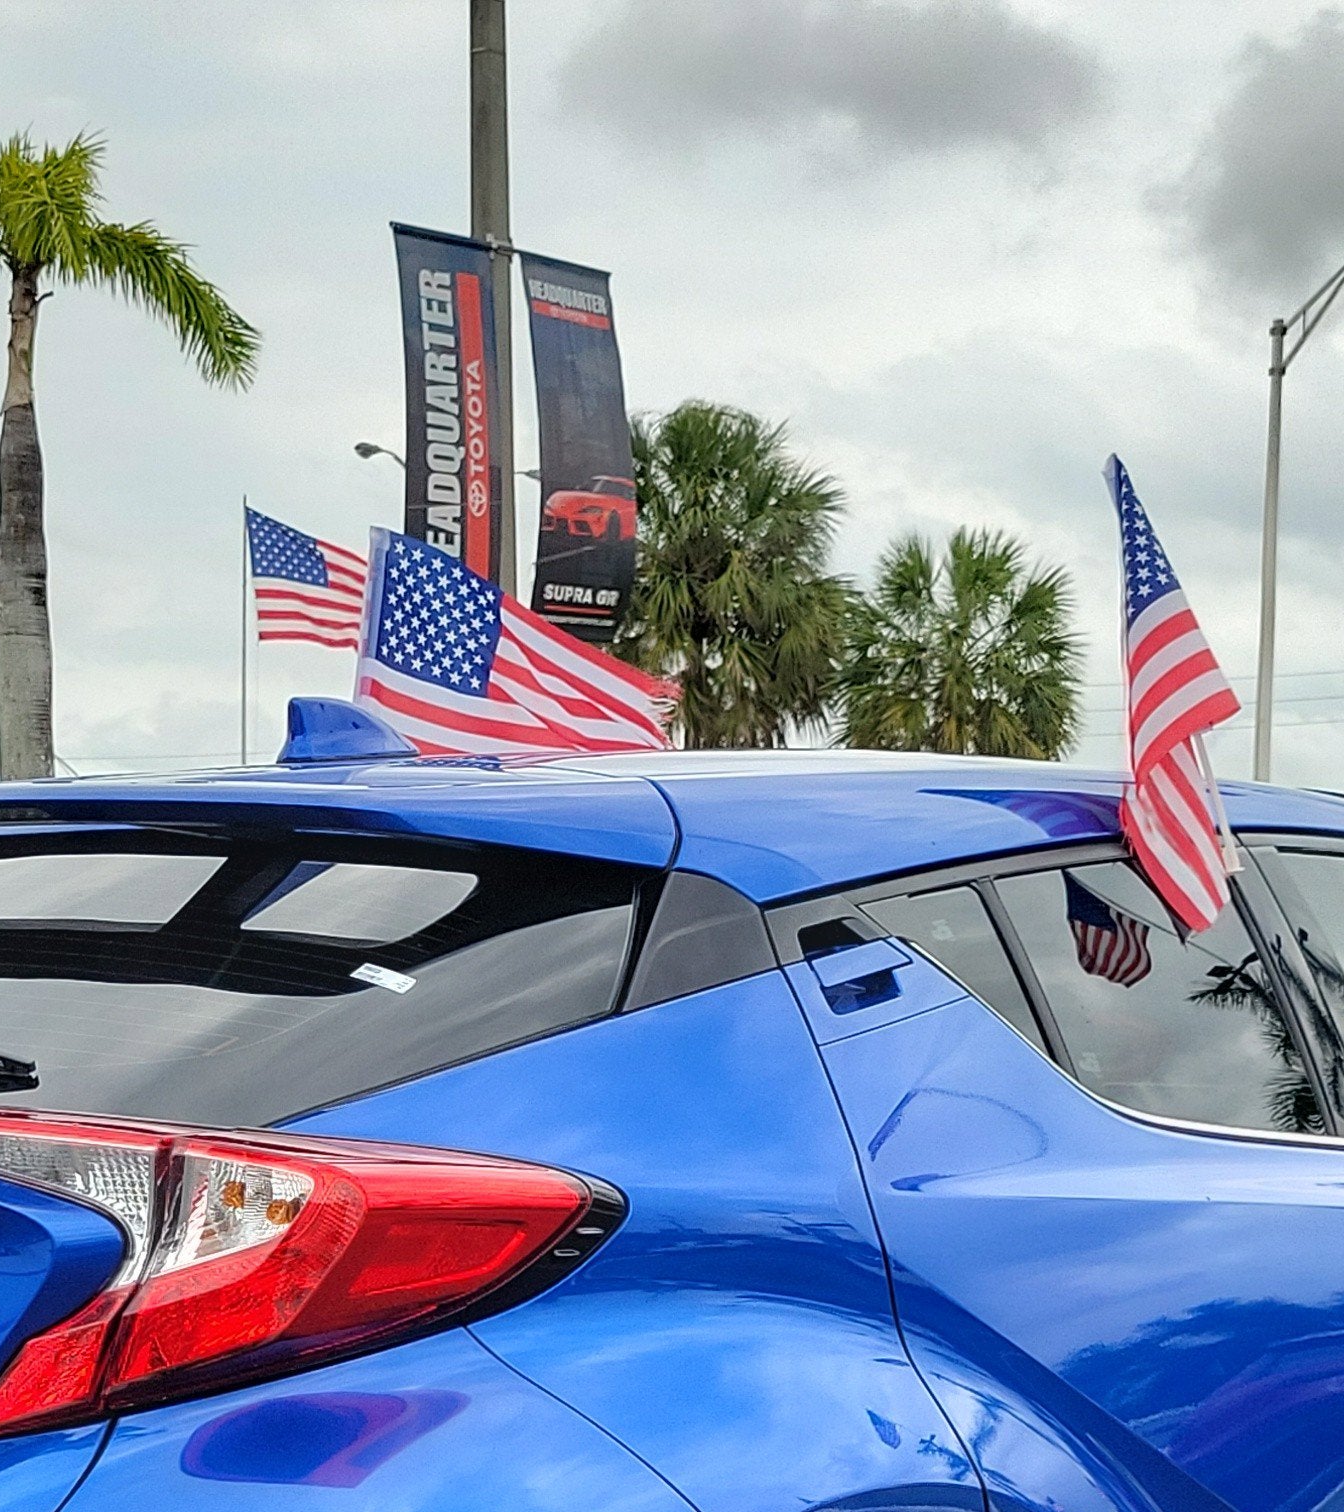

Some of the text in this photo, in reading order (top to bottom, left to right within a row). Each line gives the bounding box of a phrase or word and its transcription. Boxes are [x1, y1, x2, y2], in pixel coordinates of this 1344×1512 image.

[418, 268, 465, 558] EADQUARTER
[466, 360, 485, 476] TOYOTA
[543, 583, 593, 605] SUPRA
